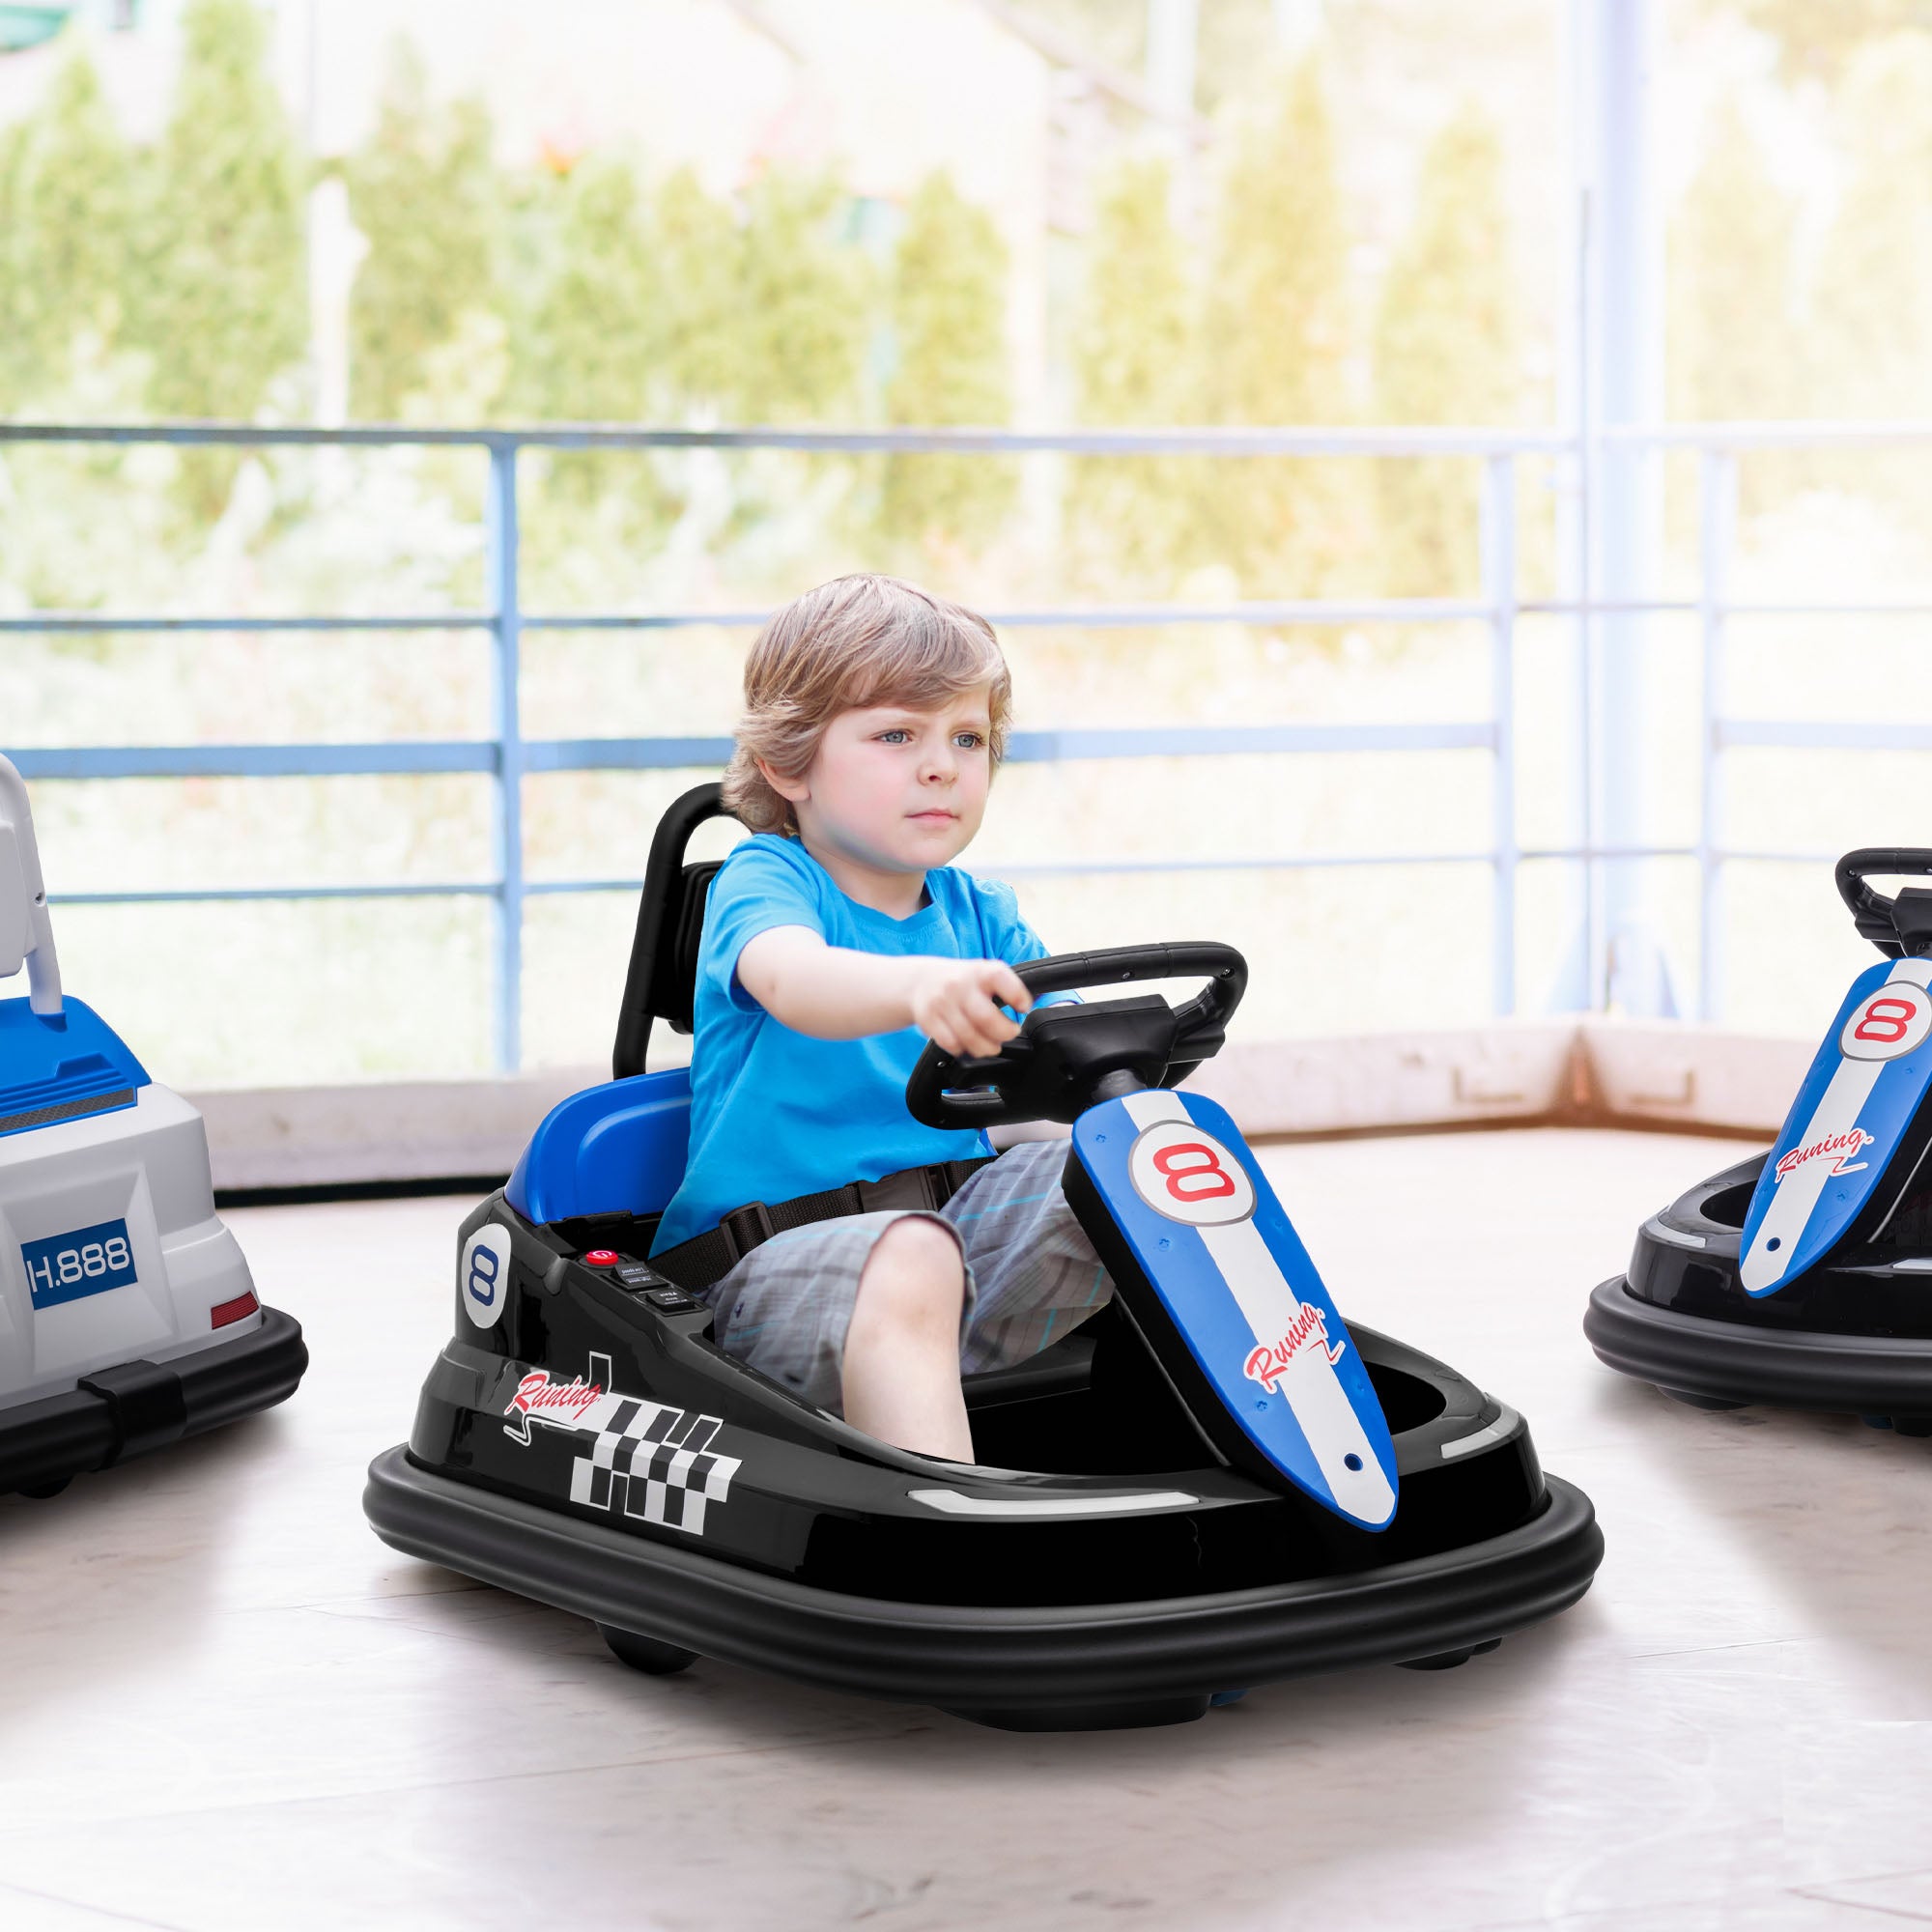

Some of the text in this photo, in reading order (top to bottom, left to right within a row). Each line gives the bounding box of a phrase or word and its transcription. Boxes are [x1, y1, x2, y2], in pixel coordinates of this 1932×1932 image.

[1854, 998, 1917, 1043] 8
[1152, 1143, 1236, 1203] 8
[27, 1236, 130, 1293] H.888
[469, 1244, 499, 1306] 8
